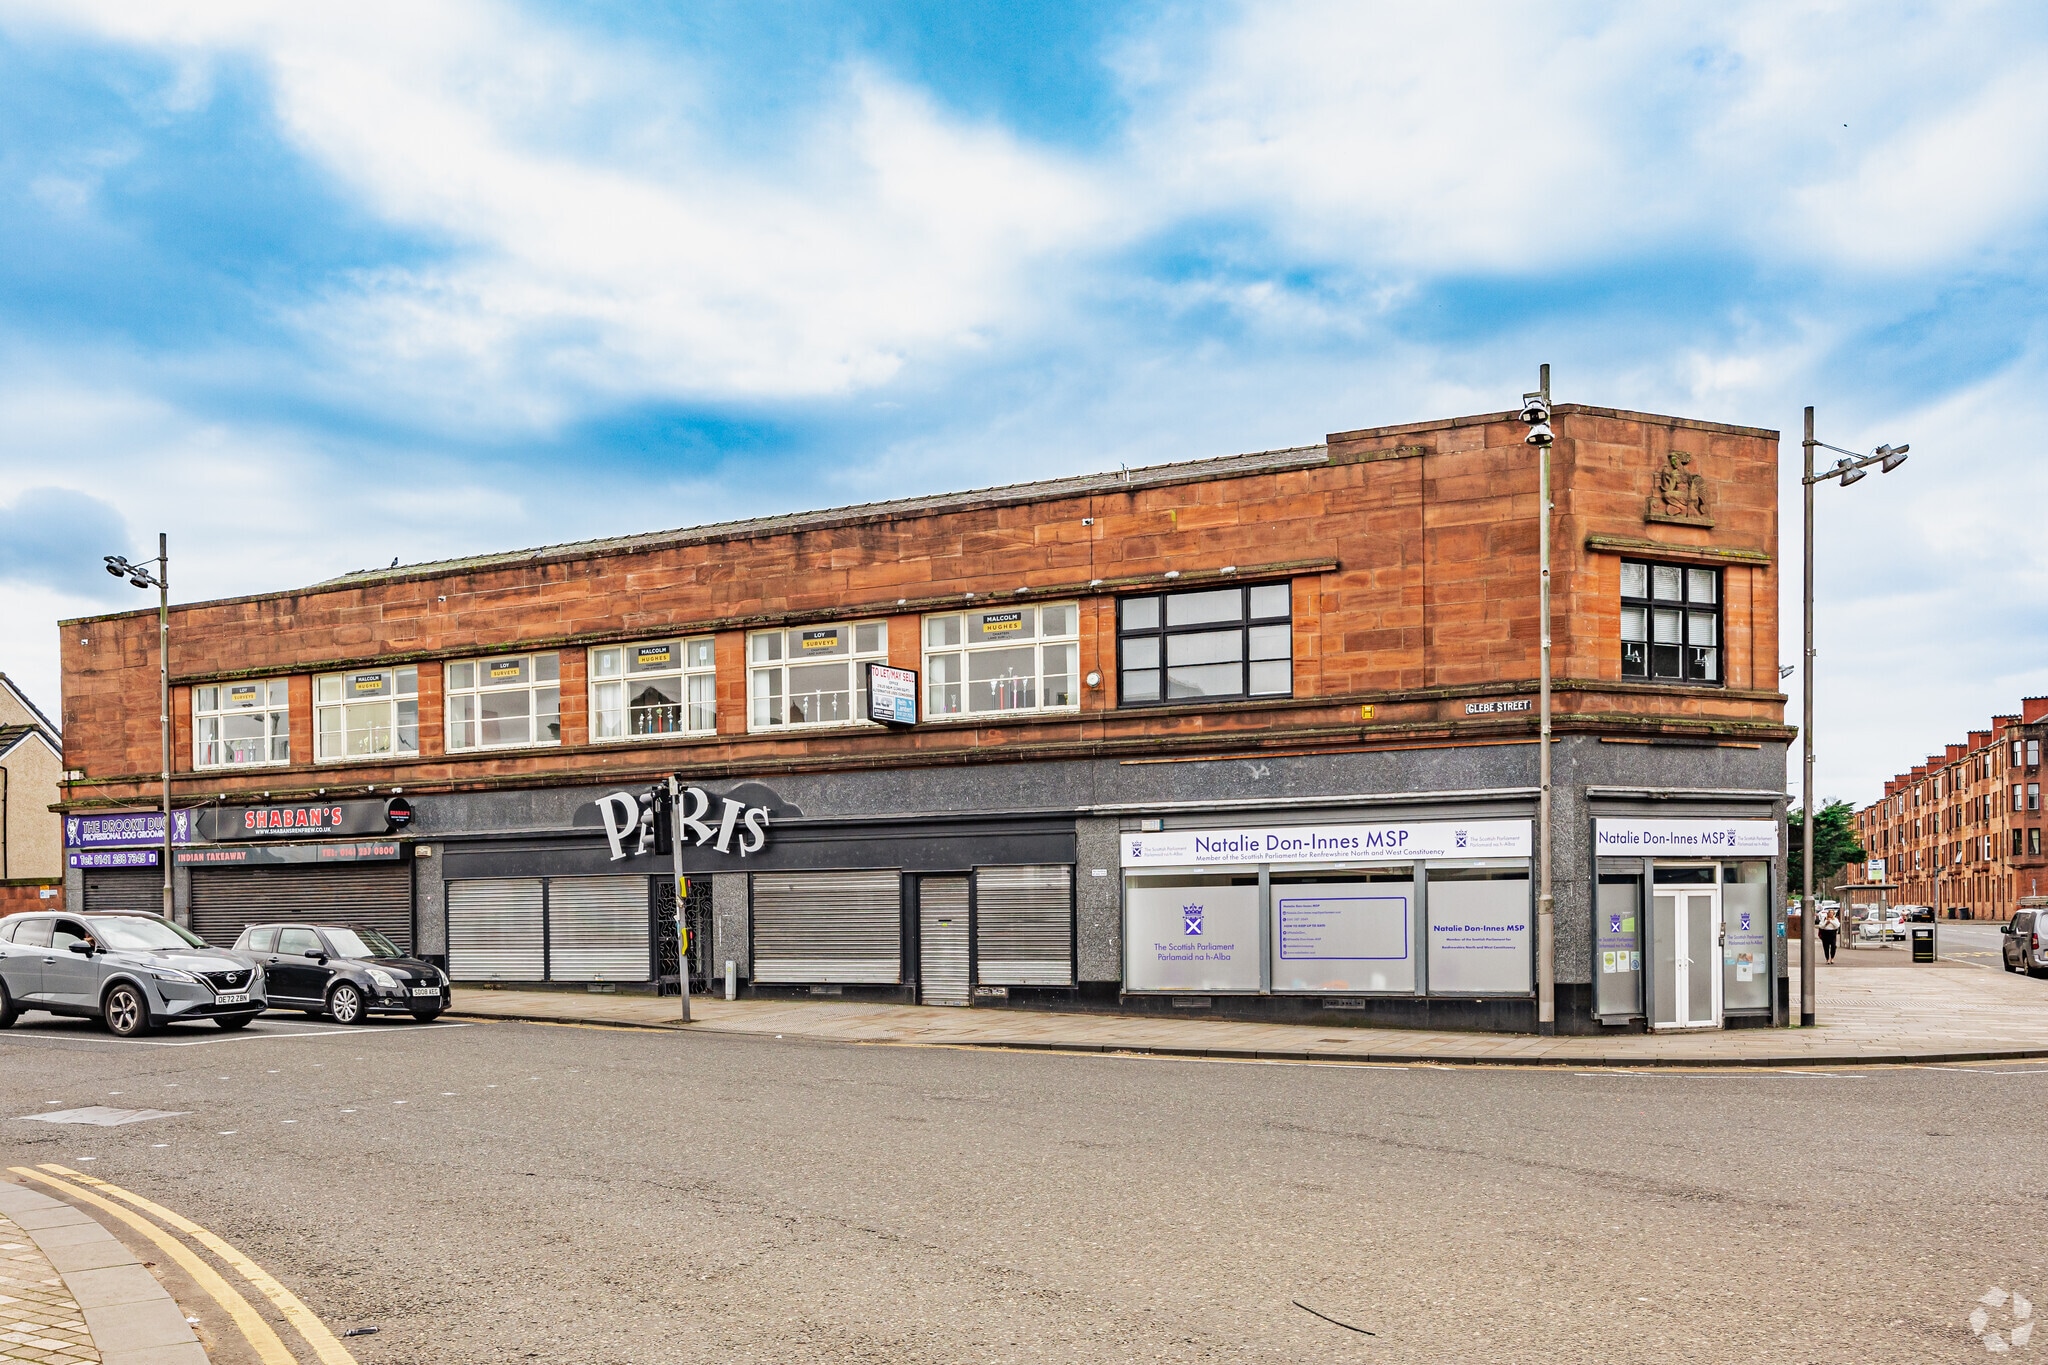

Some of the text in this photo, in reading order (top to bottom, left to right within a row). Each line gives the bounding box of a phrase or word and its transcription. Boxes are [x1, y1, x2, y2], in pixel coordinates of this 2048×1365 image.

[987, 614, 1017, 622] MALCOLM
[872, 666, 879, 677] TO
[902, 672, 914, 683] SELL
[1468, 701, 1528, 713] GLEBE STREET
[245, 807, 343, 829] SHABAN'S
[83, 820, 100, 834] THE
[102, 818, 145, 833] DROOKIT
[595, 788, 769, 861] PRIS
[83, 831, 121, 841] PROFESSIONAL
[122, 831, 136, 840] DOG
[255, 826, 331, 835] WWW.SHABANSRENFREW.CO.UK
[1196, 830, 1409, 852] Natalie Don-Innes MSP
[1599, 830, 1725, 844] Natalie Don-Innes MSP
[374, 846, 394, 855] 0800
[1265, 852, 1297, 860] Parliament
[1309, 850, 1349, 858] Renfrewshire
[1403, 848, 1445, 857] Constituency
[94, 854, 111, 865] 0141
[178, 852, 246, 862] INDIAN TAKEAWAY
[1154, 942, 1235, 951] The Scottish Parliament
[1205, 952, 1231, 960] h-Alba
